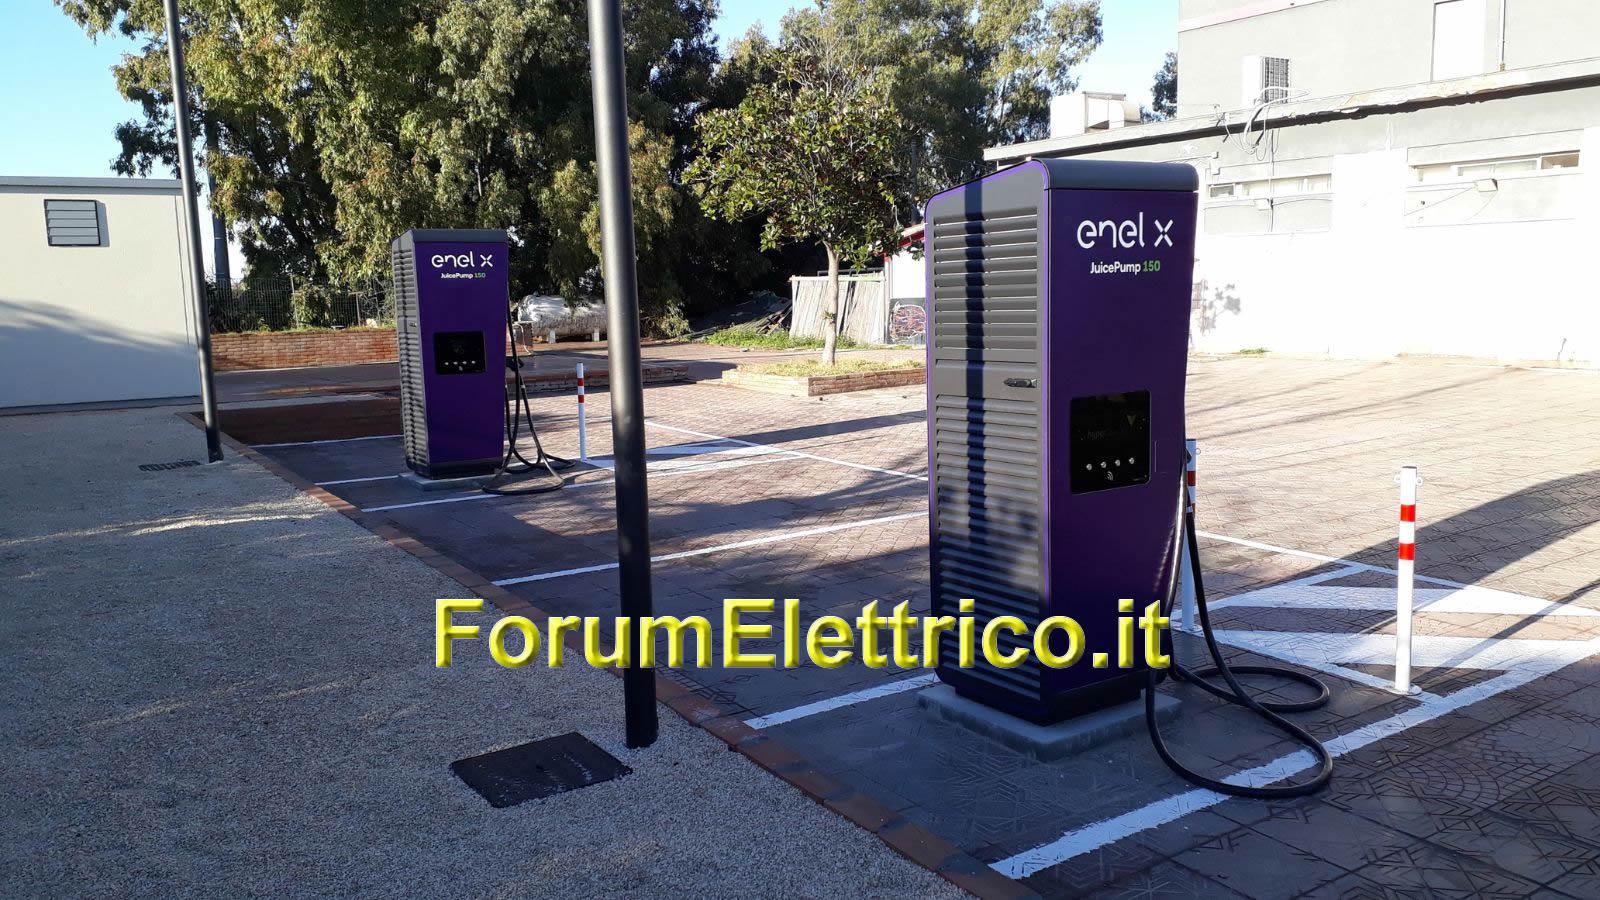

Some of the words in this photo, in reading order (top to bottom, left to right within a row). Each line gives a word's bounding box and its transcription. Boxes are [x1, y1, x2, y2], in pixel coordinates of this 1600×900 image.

[1077, 212, 1145, 249] enel
[431, 250, 475, 268] enel
[1090, 261, 1141, 275] JuicePump
[1142, 260, 1161, 272] 150
[440, 272, 474, 280] JuicePump
